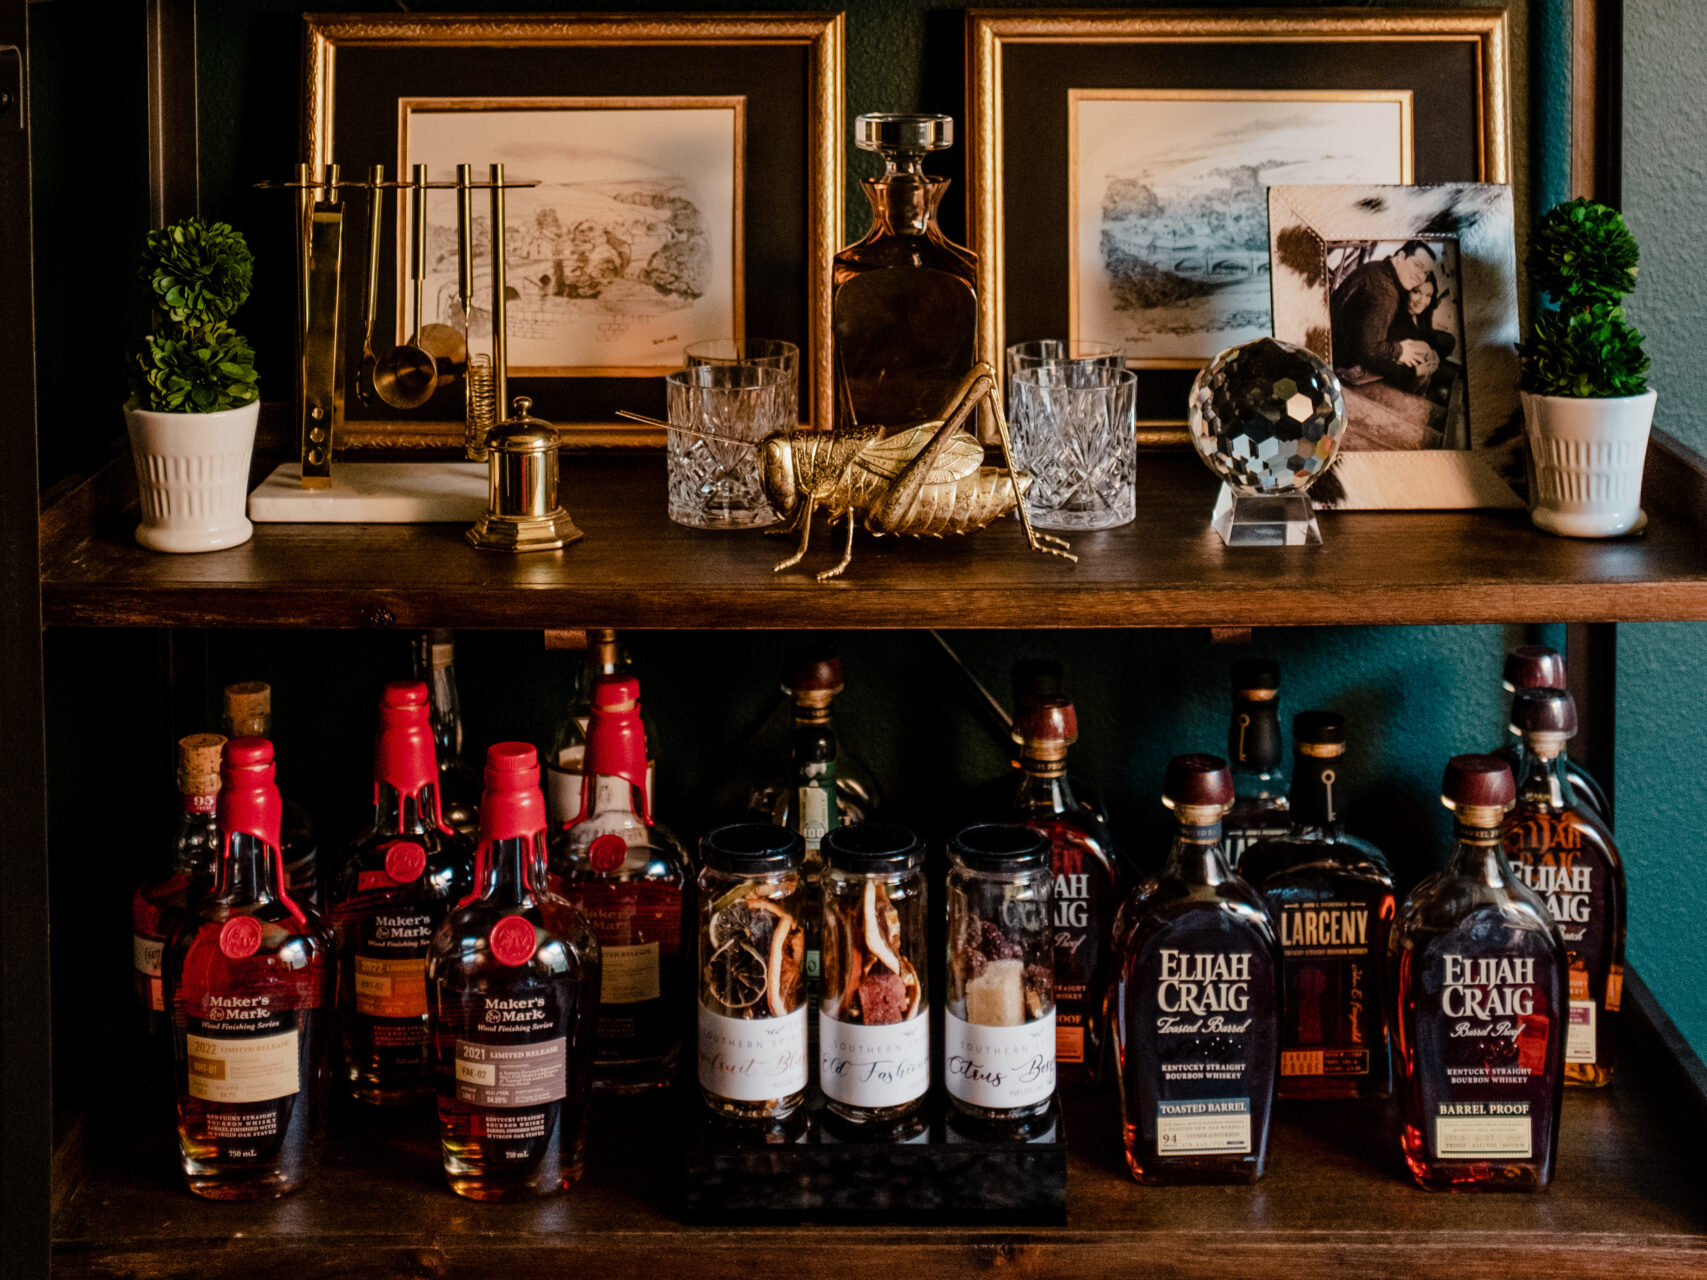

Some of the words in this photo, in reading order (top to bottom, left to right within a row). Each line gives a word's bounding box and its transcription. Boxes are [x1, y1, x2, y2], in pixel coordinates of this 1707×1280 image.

[193, 795, 214, 806] 95
[1547, 895, 1592, 923] AIG
[375, 915, 431, 927] Maker's
[390, 926, 432, 938] Mark
[1281, 909, 1369, 947] LARCENY
[1158, 949, 1252, 990] ELIJAH
[1442, 955, 1536, 993] ELIJAH
[209, 995, 270, 1008] Maker's
[484, 997, 545, 1009] Maker's
[1157, 980, 1250, 1016] CRAIG
[1441, 986, 1535, 1020] CRAIG
[225, 1007, 271, 1020] Mark
[502, 1009, 546, 1022] Mark
[221, 1022, 256, 1031] Finishing
[256, 1020, 280, 1029] Series
[477, 1024, 497, 1032] Wood
[498, 1024, 530, 1033] Finishing
[1156, 1016, 1203, 1034] Toasted
[1201, 1016, 1252, 1034] Barrel
[1449, 1022, 1489, 1039] Barrel
[1488, 1022, 1527, 1042] Proof
[193, 1041, 217, 1055] 2022
[220, 1045, 255, 1054] LIMITED
[255, 1041, 290, 1053] RELEASE
[463, 1045, 486, 1060] 2021
[490, 1050, 525, 1059] LIMITED
[525, 1045, 559, 1058] RELEASE
[960, 1041, 1029, 1055] SOUTHERN
[462, 1066, 487, 1080] FAE-02
[948, 1055, 1007, 1087] Citrus
[1161, 1064, 1204, 1072] KENTUCKY
[1206, 1063, 1247, 1071] STRAIGHT
[1447, 1068, 1489, 1076] KENTUCKY
[1492, 1068, 1533, 1076] STRAIGHT
[1165, 1072, 1204, 1080] BOURBON
[1205, 1072, 1242, 1080] WHISKEY
[1451, 1076, 1490, 1084] BOURBON
[1491, 1076, 1528, 1084] WHISKEY
[1160, 1103, 1207, 1115] TOASTED
[1207, 1101, 1247, 1113] BARREL
[1439, 1104, 1487, 1115] BARREL
[1489, 1104, 1529, 1114] PROOF
[242, 1111, 277, 1120] STRAIGHT
[246, 1118, 277, 1126] WHISKY
[259, 1123, 277, 1131] WITH
[1162, 1134, 1177, 1144] 94
[228, 1148, 242, 1158] 750
[505, 1151, 517, 1159] 750
